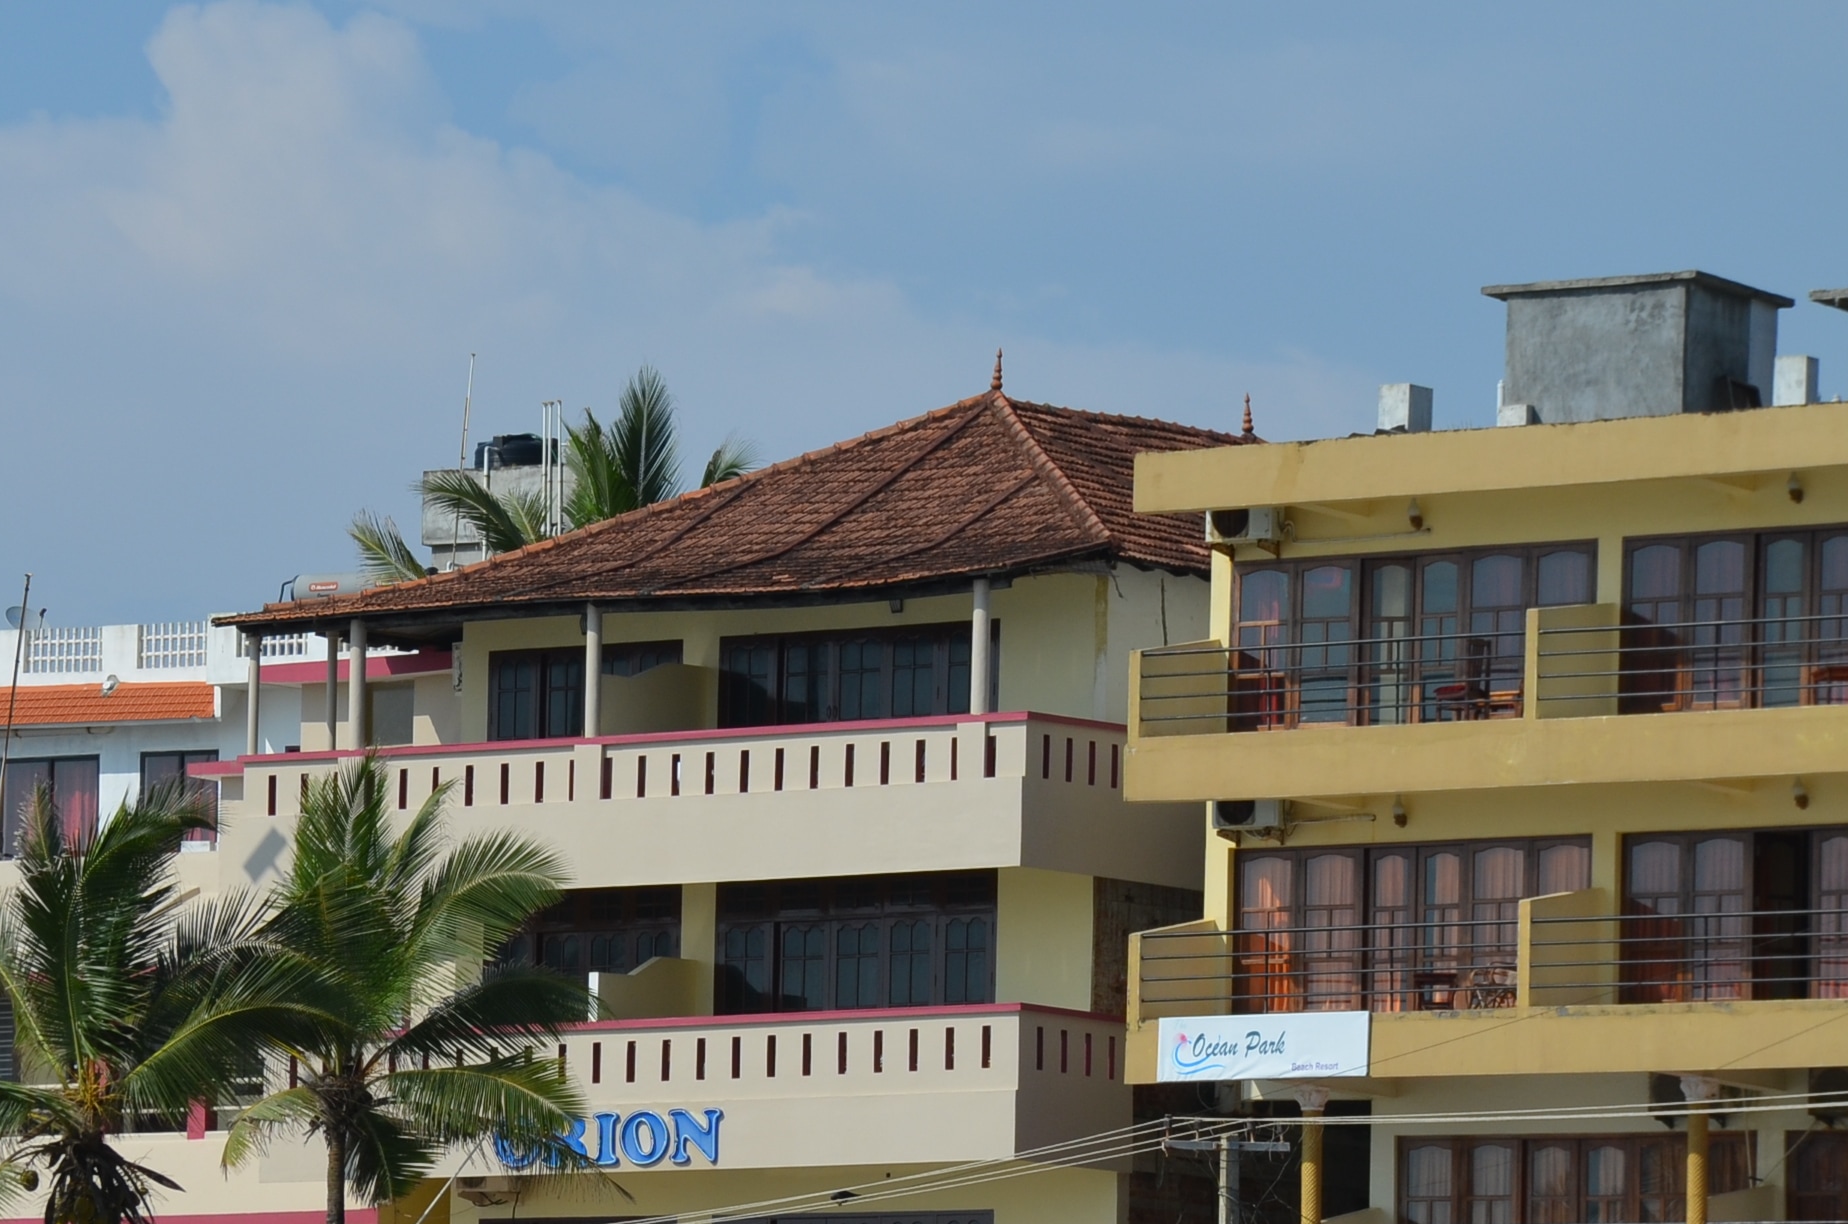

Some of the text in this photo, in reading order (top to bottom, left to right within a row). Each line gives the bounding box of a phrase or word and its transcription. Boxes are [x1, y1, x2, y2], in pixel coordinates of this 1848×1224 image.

[1244, 1030, 1287, 1058] Park
[1291, 1062, 1339, 1072] Beach Resort
